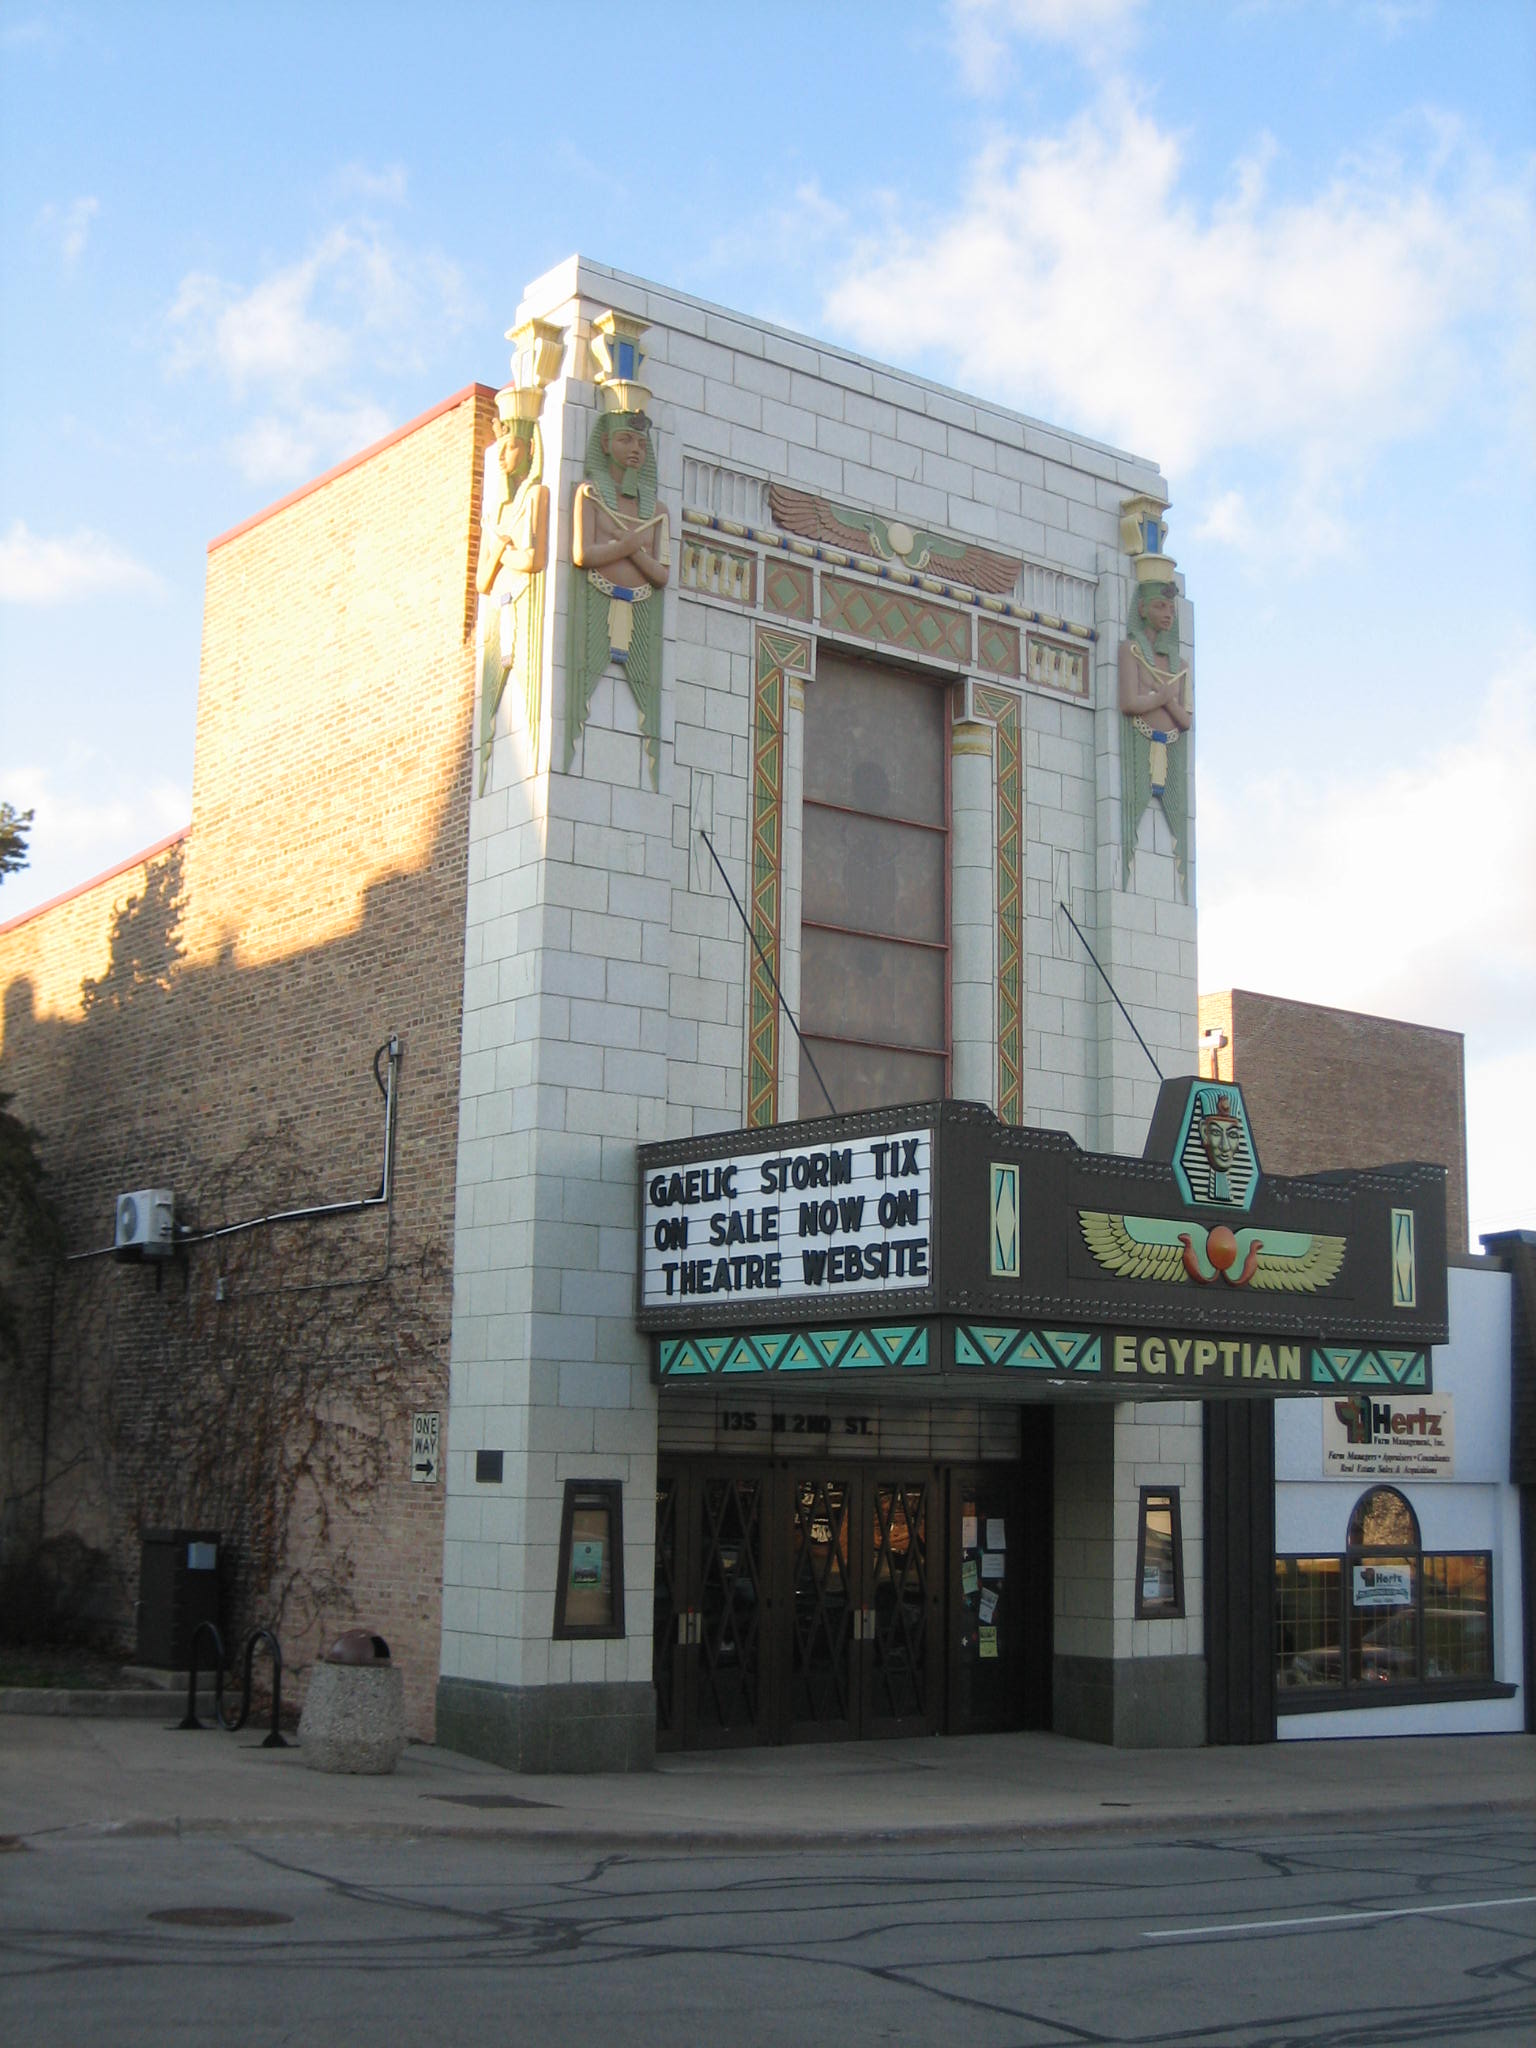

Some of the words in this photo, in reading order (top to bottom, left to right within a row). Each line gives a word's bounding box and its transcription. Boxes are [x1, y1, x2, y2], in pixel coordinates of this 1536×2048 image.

[650, 1165, 737, 1207] GAELIC
[760, 1148, 852, 1194] STORM
[870, 1138, 919, 1180] TIX
[655, 1216, 688, 1251] ON
[709, 1206, 779, 1246] SALE
[799, 1195, 865, 1237] NOW
[878, 1188, 919, 1228] ON
[662, 1252, 782, 1296] THEATRE
[802, 1238, 928, 1286] WEBSITE
[1114, 1335, 1301, 1381] EGYPTIAN
[416, 1418, 437, 1434] ONE
[723, 1411, 757, 1432] 135
[792, 1413, 832, 1434] 2ND
[1373, 1404, 1442, 1435] Hertz
[415, 1438, 436, 1454] WAY
[1374, 1436, 1390, 1445] Farm
[1328, 1451, 1345, 1460] Farm
